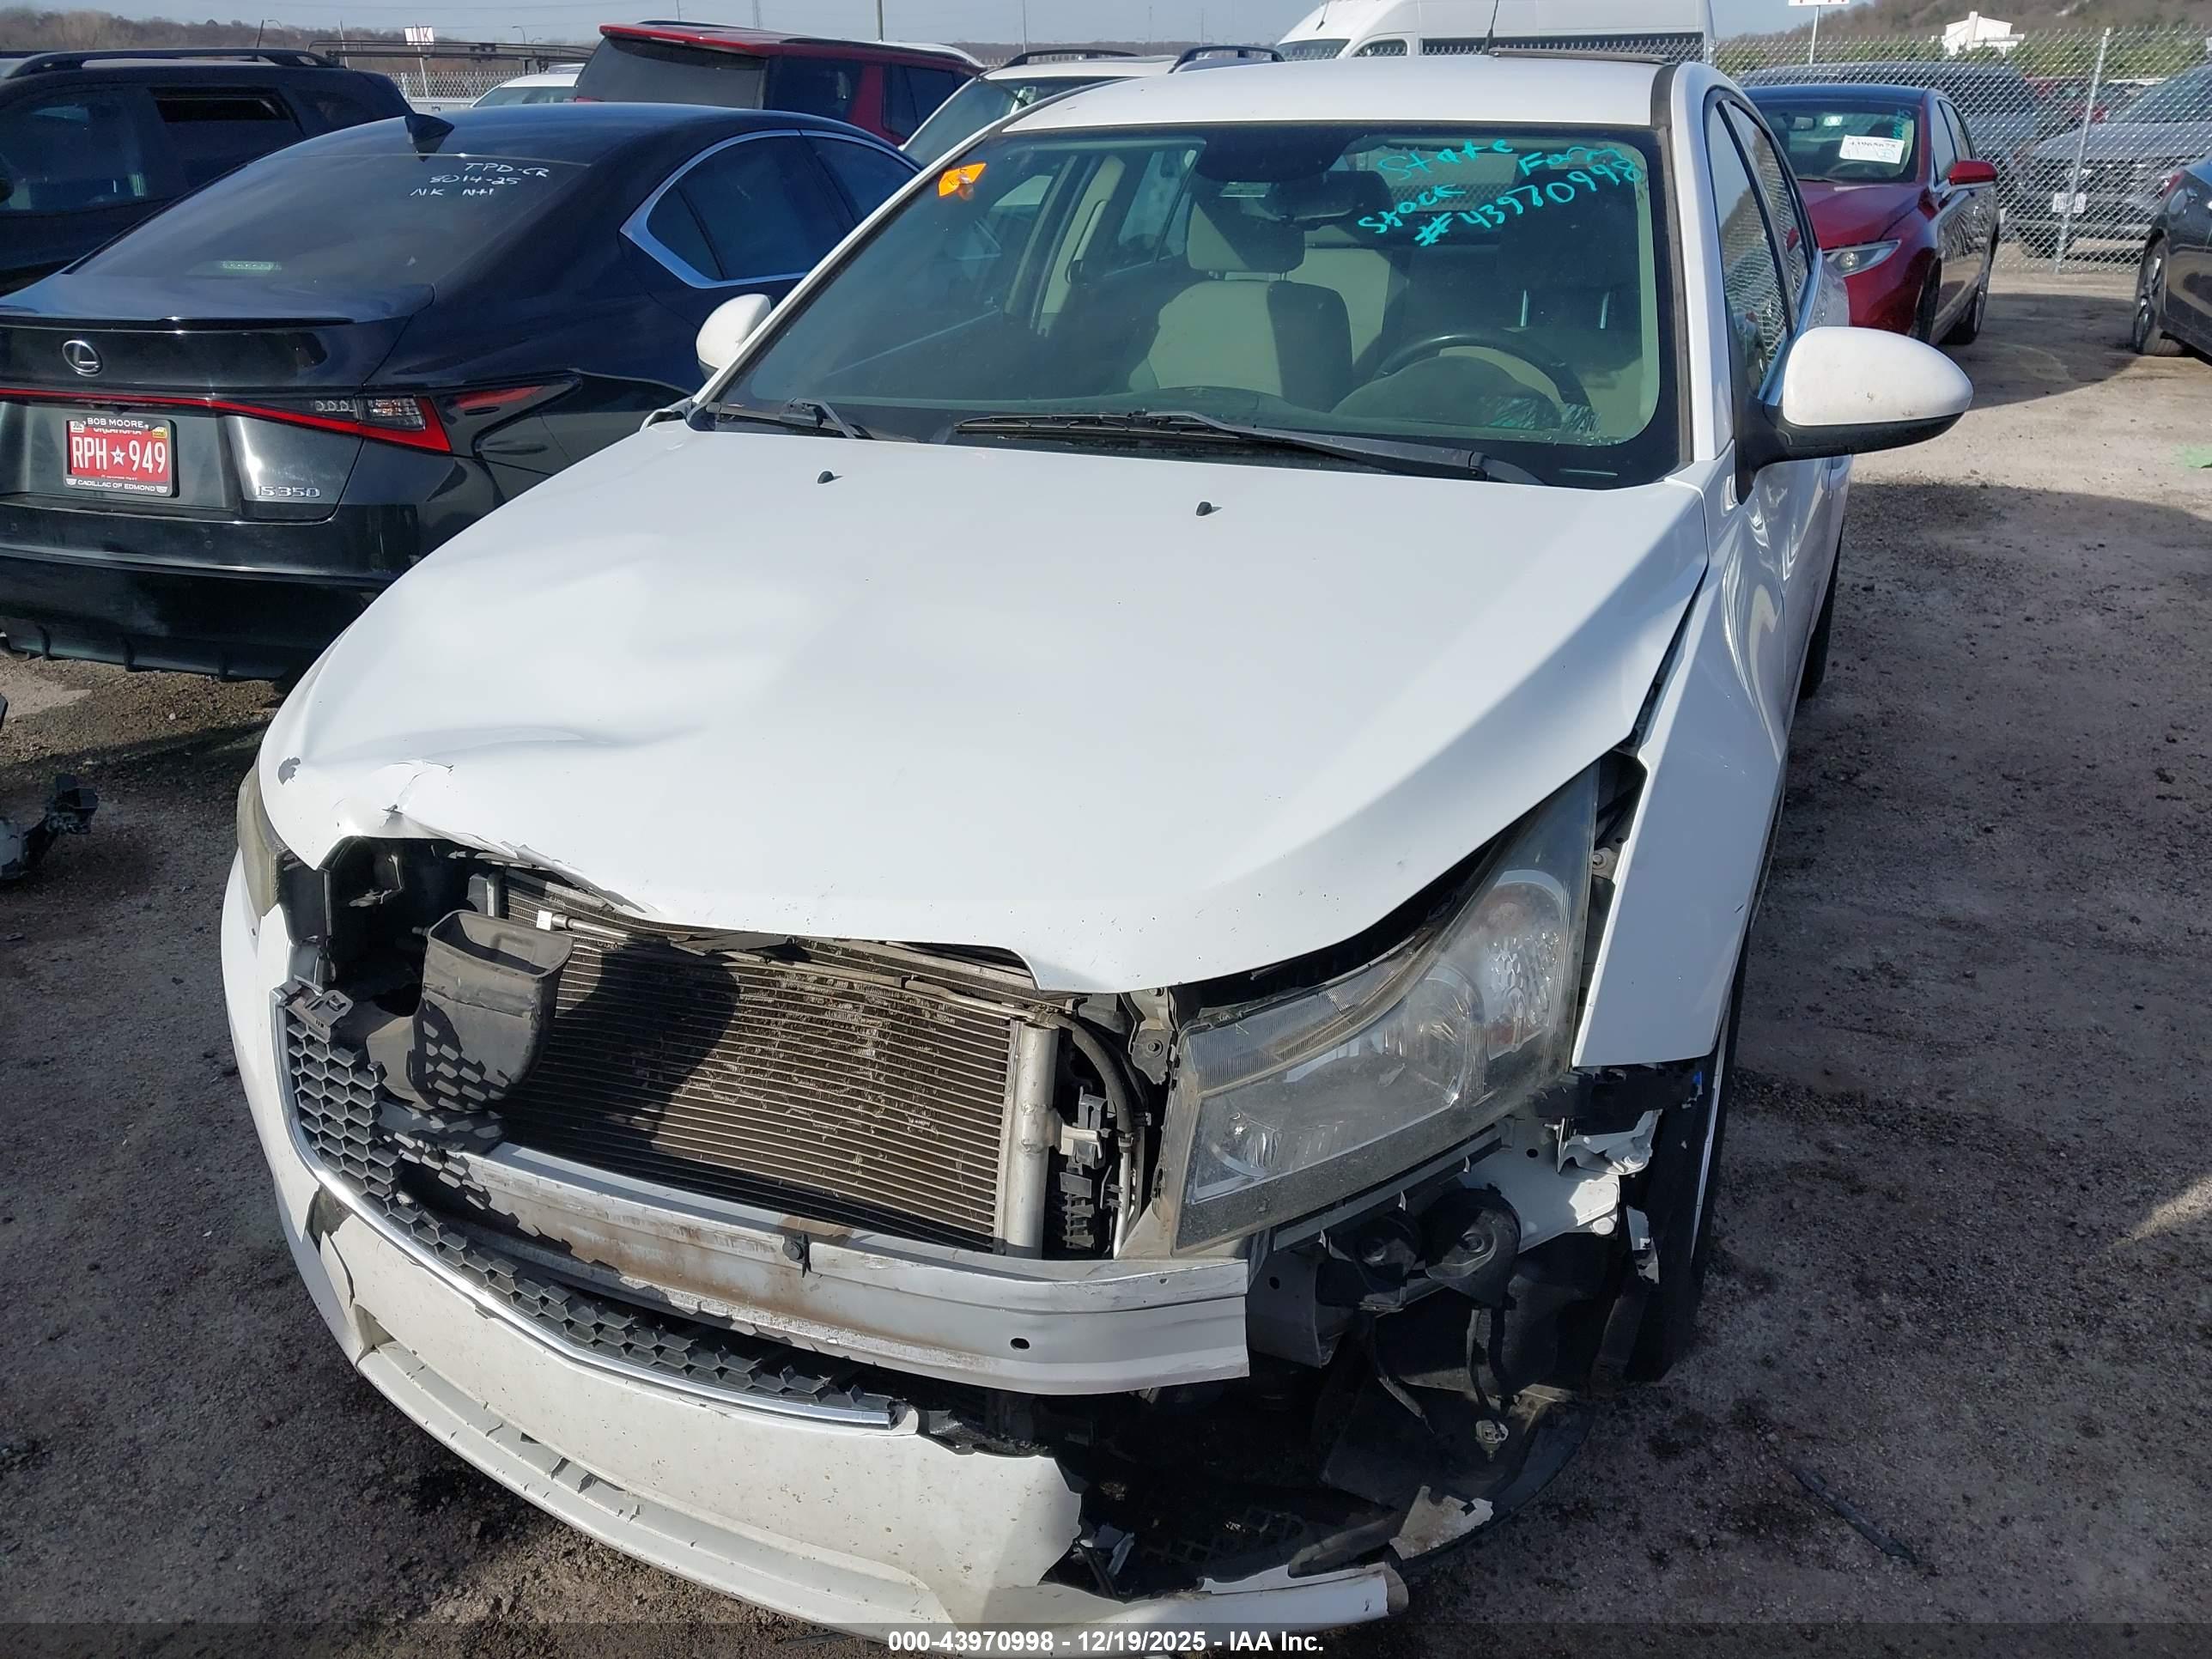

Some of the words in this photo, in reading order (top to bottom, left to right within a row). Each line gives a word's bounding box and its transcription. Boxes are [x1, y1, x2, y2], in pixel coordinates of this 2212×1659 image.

[1378, 140, 1513, 179] State
[1358, 184, 1466, 233] Stock
[87, 417, 106, 426] BOB
[108, 419, 144, 428] MOORE
[71, 436, 107, 471] RPH
[128, 440, 167, 474] 949
[77, 479, 112, 488] CADILLAC
[124, 483, 156, 492] EDMOND
